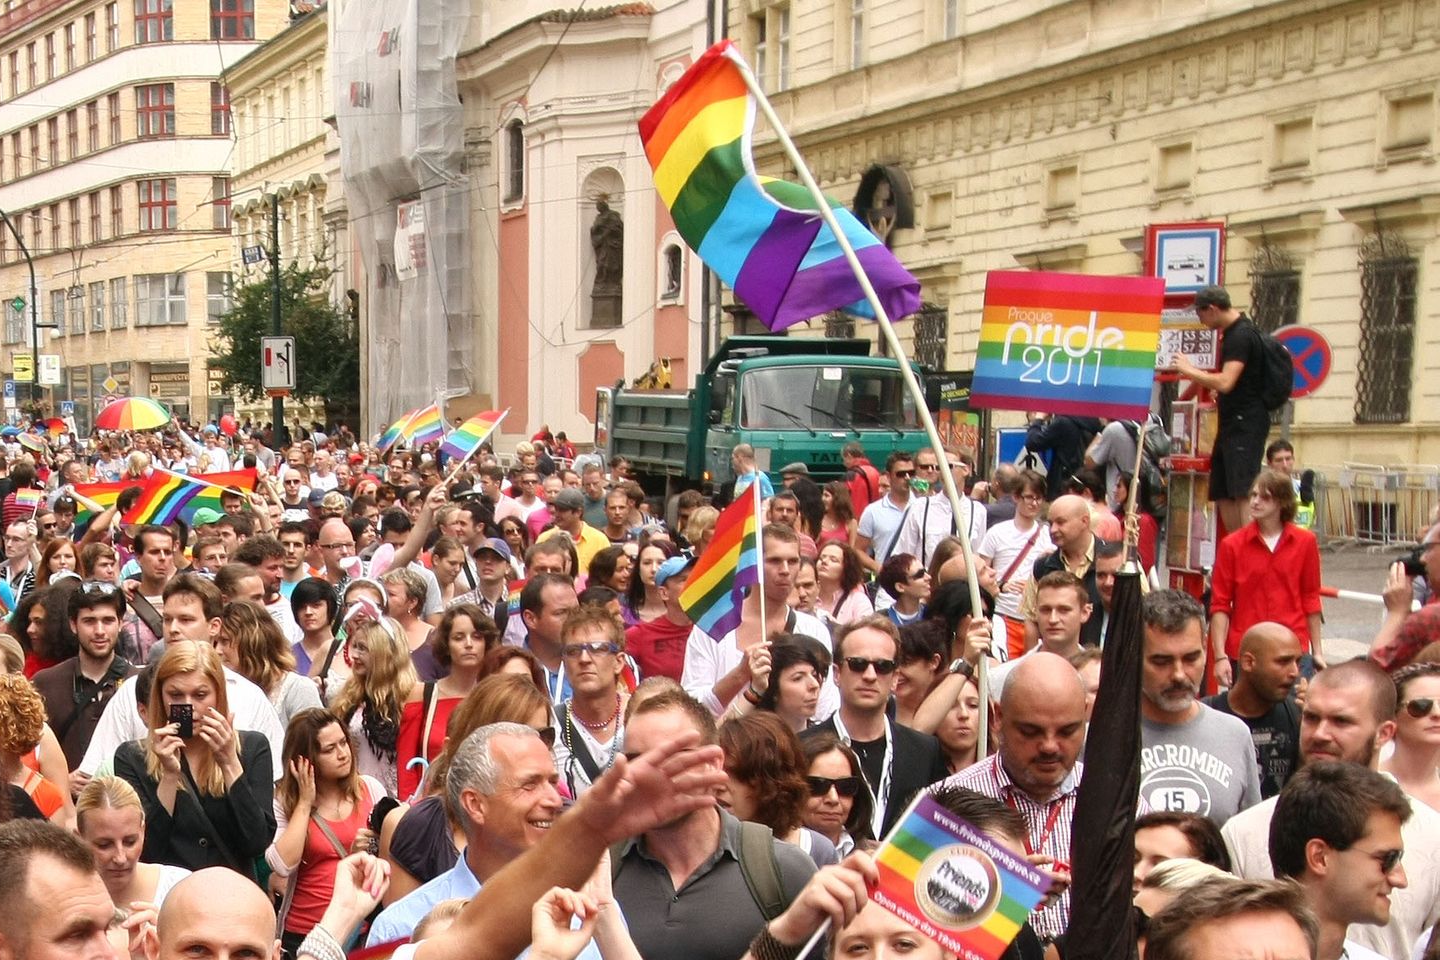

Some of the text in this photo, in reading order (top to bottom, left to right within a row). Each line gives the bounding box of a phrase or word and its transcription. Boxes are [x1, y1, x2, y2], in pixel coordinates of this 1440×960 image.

[1008, 306, 1054, 324] Prague
[1019, 346, 1102, 387] 2011
[811, 452, 842, 463] TAT
[1141, 743, 1233, 789] RCROMBIE
[1164, 791, 1186, 812] 15
[873, 890, 897, 911] Open
